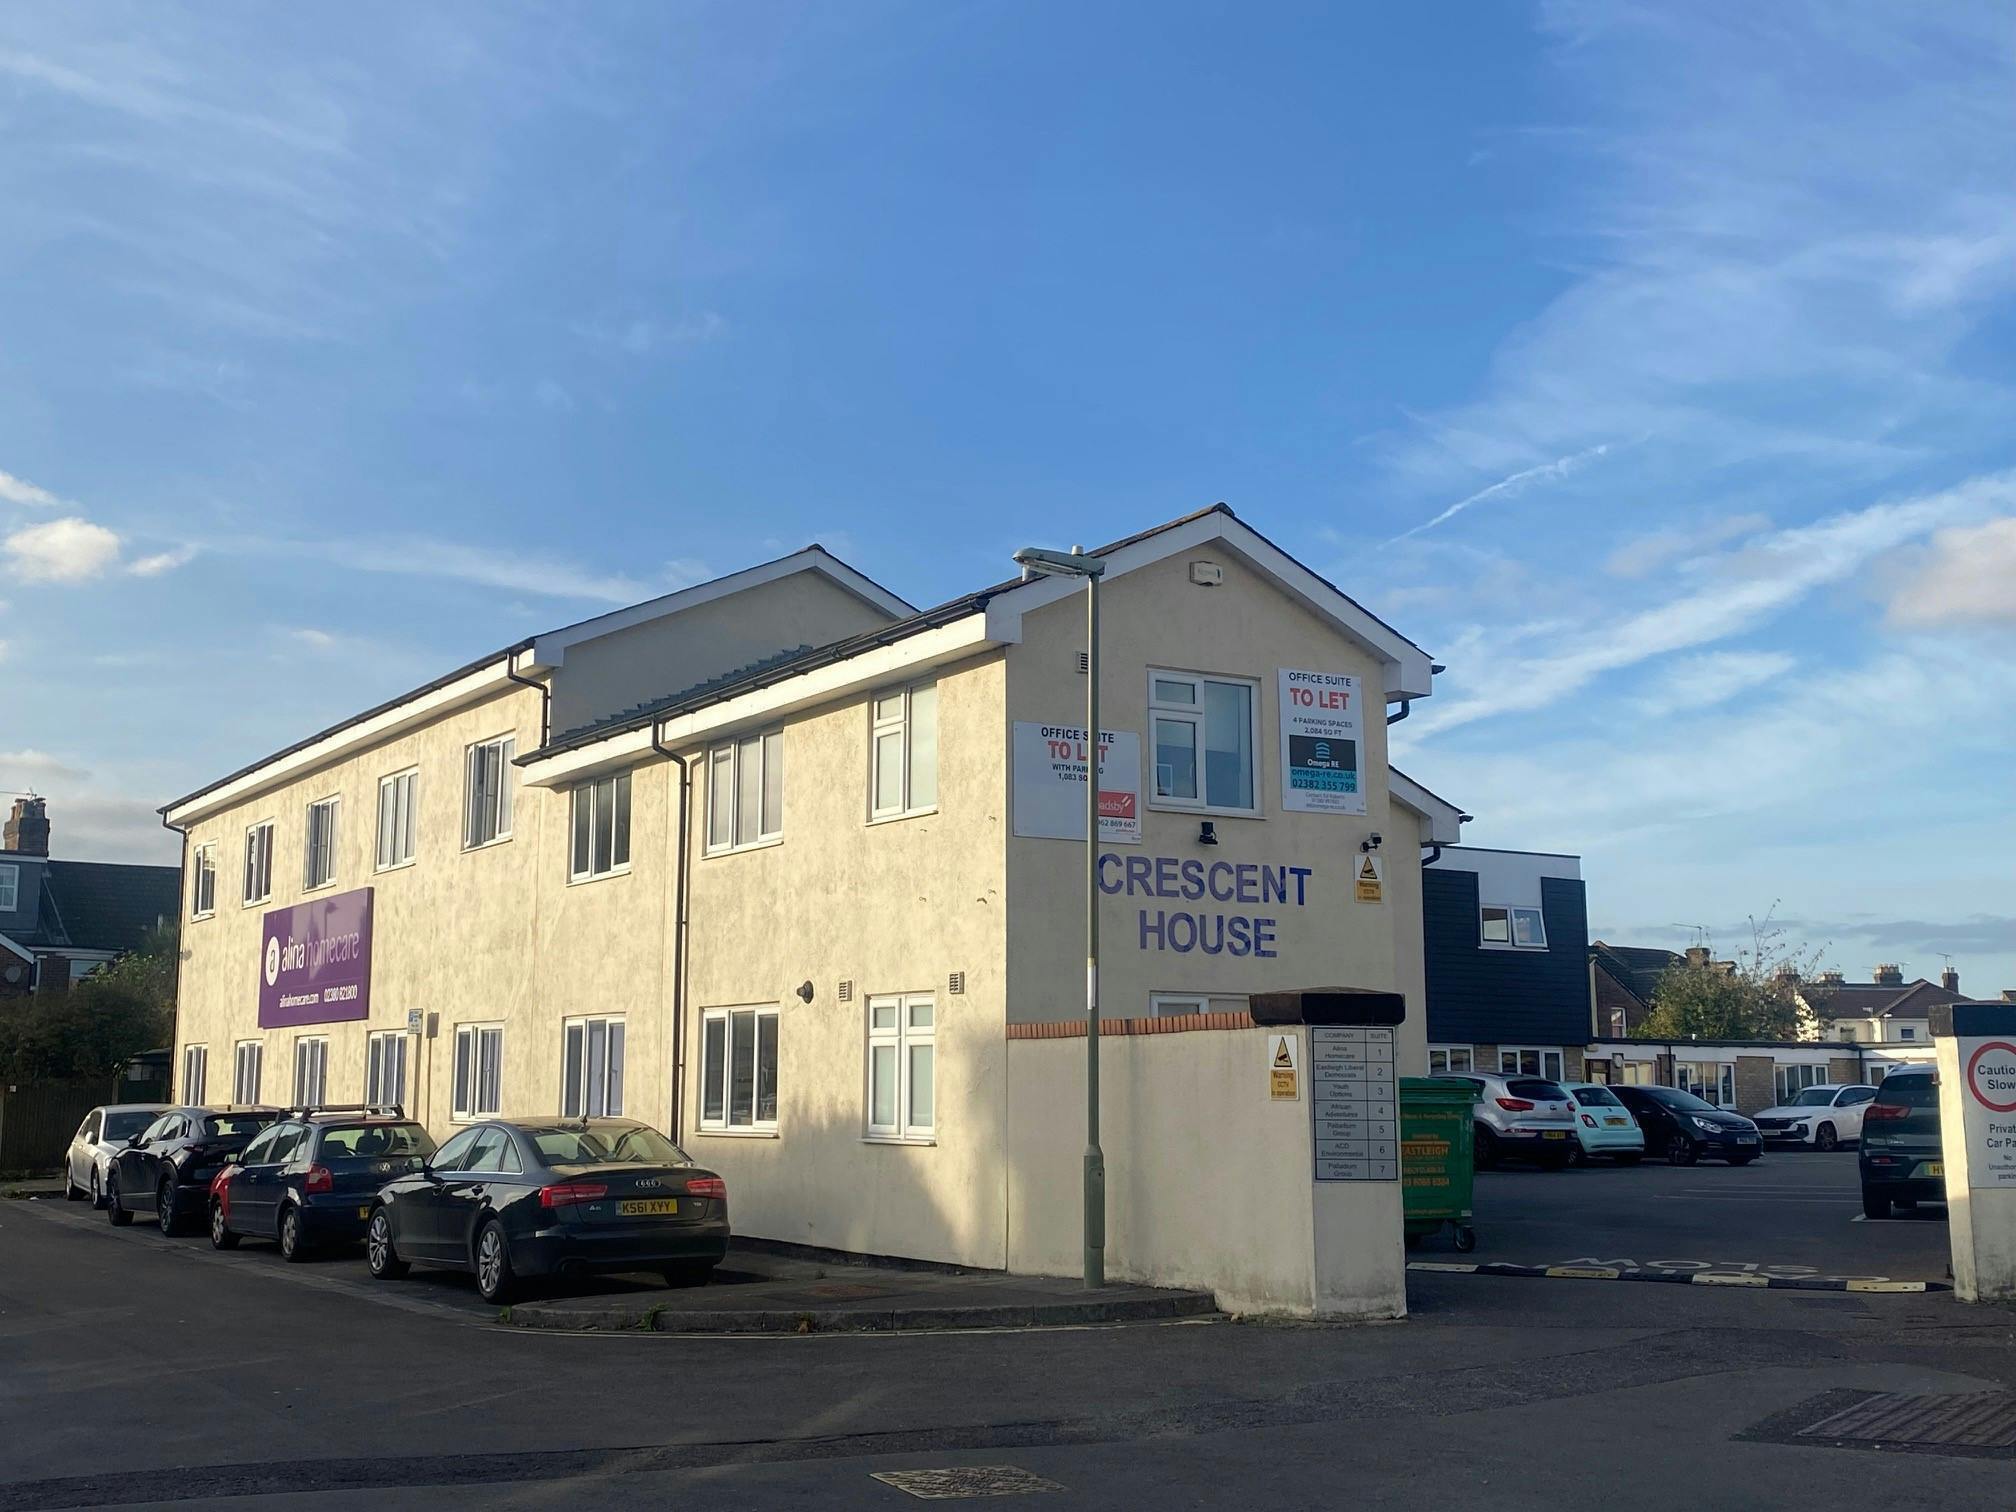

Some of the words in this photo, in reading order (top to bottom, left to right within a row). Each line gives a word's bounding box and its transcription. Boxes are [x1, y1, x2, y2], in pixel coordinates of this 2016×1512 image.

[1289, 672, 1323, 684] OFFICE
[1325, 675, 1352, 687] SUITE
[1290, 688, 1314, 707] TO
[1319, 691, 1350, 710] LET
[1299, 717, 1328, 726] PARKING
[1328, 720, 1353, 728] SPACES
[1041, 727, 1080, 740] OFFICE
[1083, 732, 1115, 743] SITE
[1048, 740, 1071, 760] TO
[1077, 743, 1109, 763] LT
[1052, 763, 1071, 771] WITH
[1307, 758, 1330, 768] Omega
[1331, 760, 1340, 768] RE
[1291, 769, 1356, 780] omega-re.co.uk
[1292, 779, 1320, 790] 02382
[1321, 781, 1338, 791] 355
[1340, 782, 1356, 792] 799
[1098, 799, 1123, 814] adsby
[1098, 853, 1313, 906] CRESCENT
[1139, 910, 1278, 958] HOUSE
[282, 935, 305, 972] alina
[306, 931, 360, 967] homecare
[1378, 1048, 1382, 1057] 1
[1377, 1067, 1383, 1076] 2
[1977, 1064, 2016, 1075] Cautio
[1273, 1071, 1294, 1081] Warning
[1987, 1079, 2016, 1090] Slow
[1377, 1087, 1383, 1096] 3
[1378, 1106, 1384, 1115] 4
[1378, 1125, 1385, 1134] 5
[1989, 1123, 2016, 1134] Privat
[1987, 1138, 2003, 1148] Car
[1379, 1145, 1385, 1154] 6
[1379, 1165, 1385, 1174] 7
[622, 1202, 648, 1214] KS61
[650, 1201, 671, 1212] XYY
